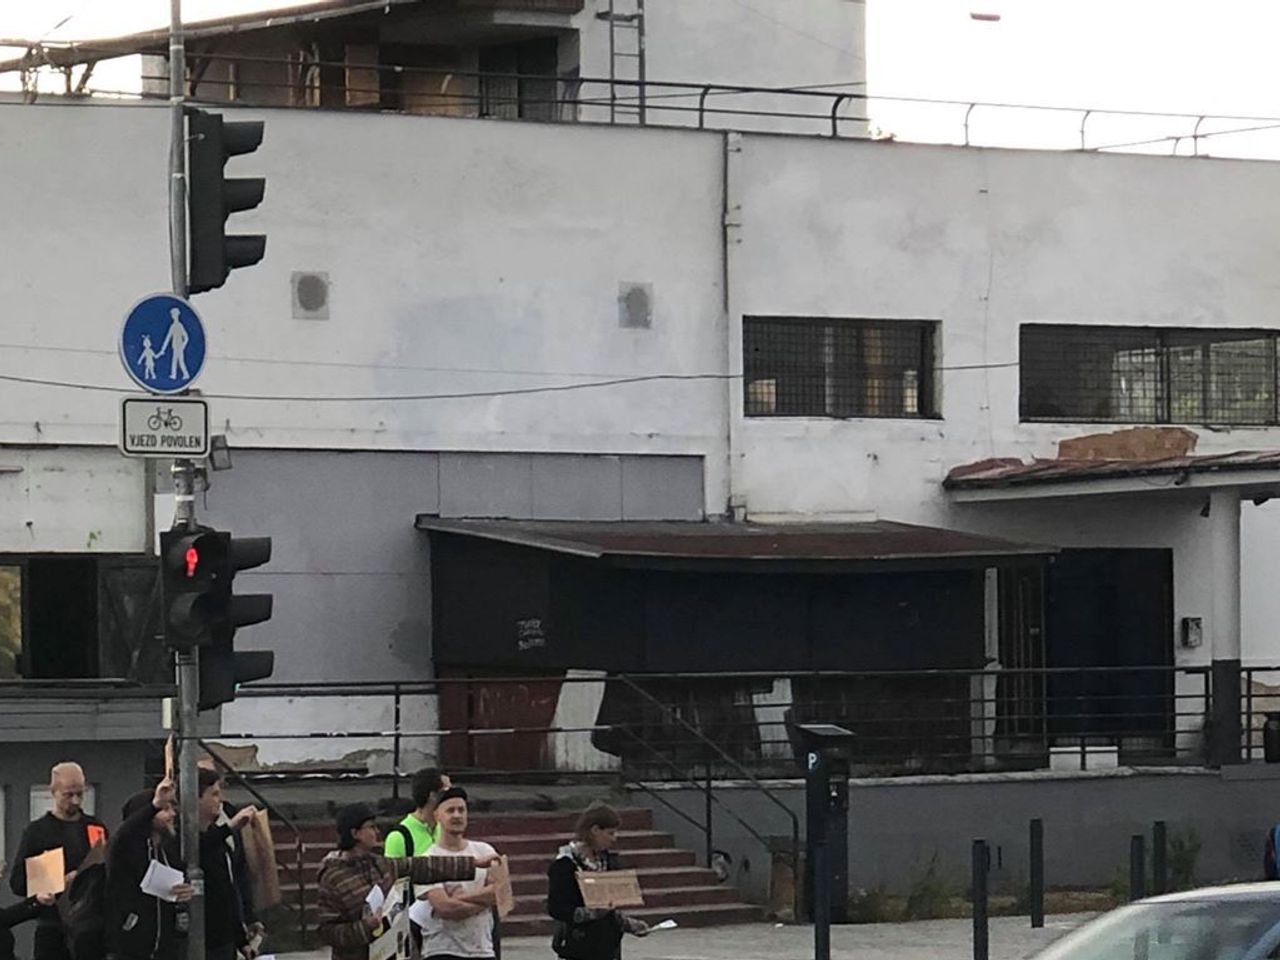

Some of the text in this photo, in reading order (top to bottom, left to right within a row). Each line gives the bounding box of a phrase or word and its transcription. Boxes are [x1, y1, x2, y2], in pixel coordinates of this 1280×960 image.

[129, 434, 202, 448] VJEZD POVOLEN
[808, 752, 818, 770] P
